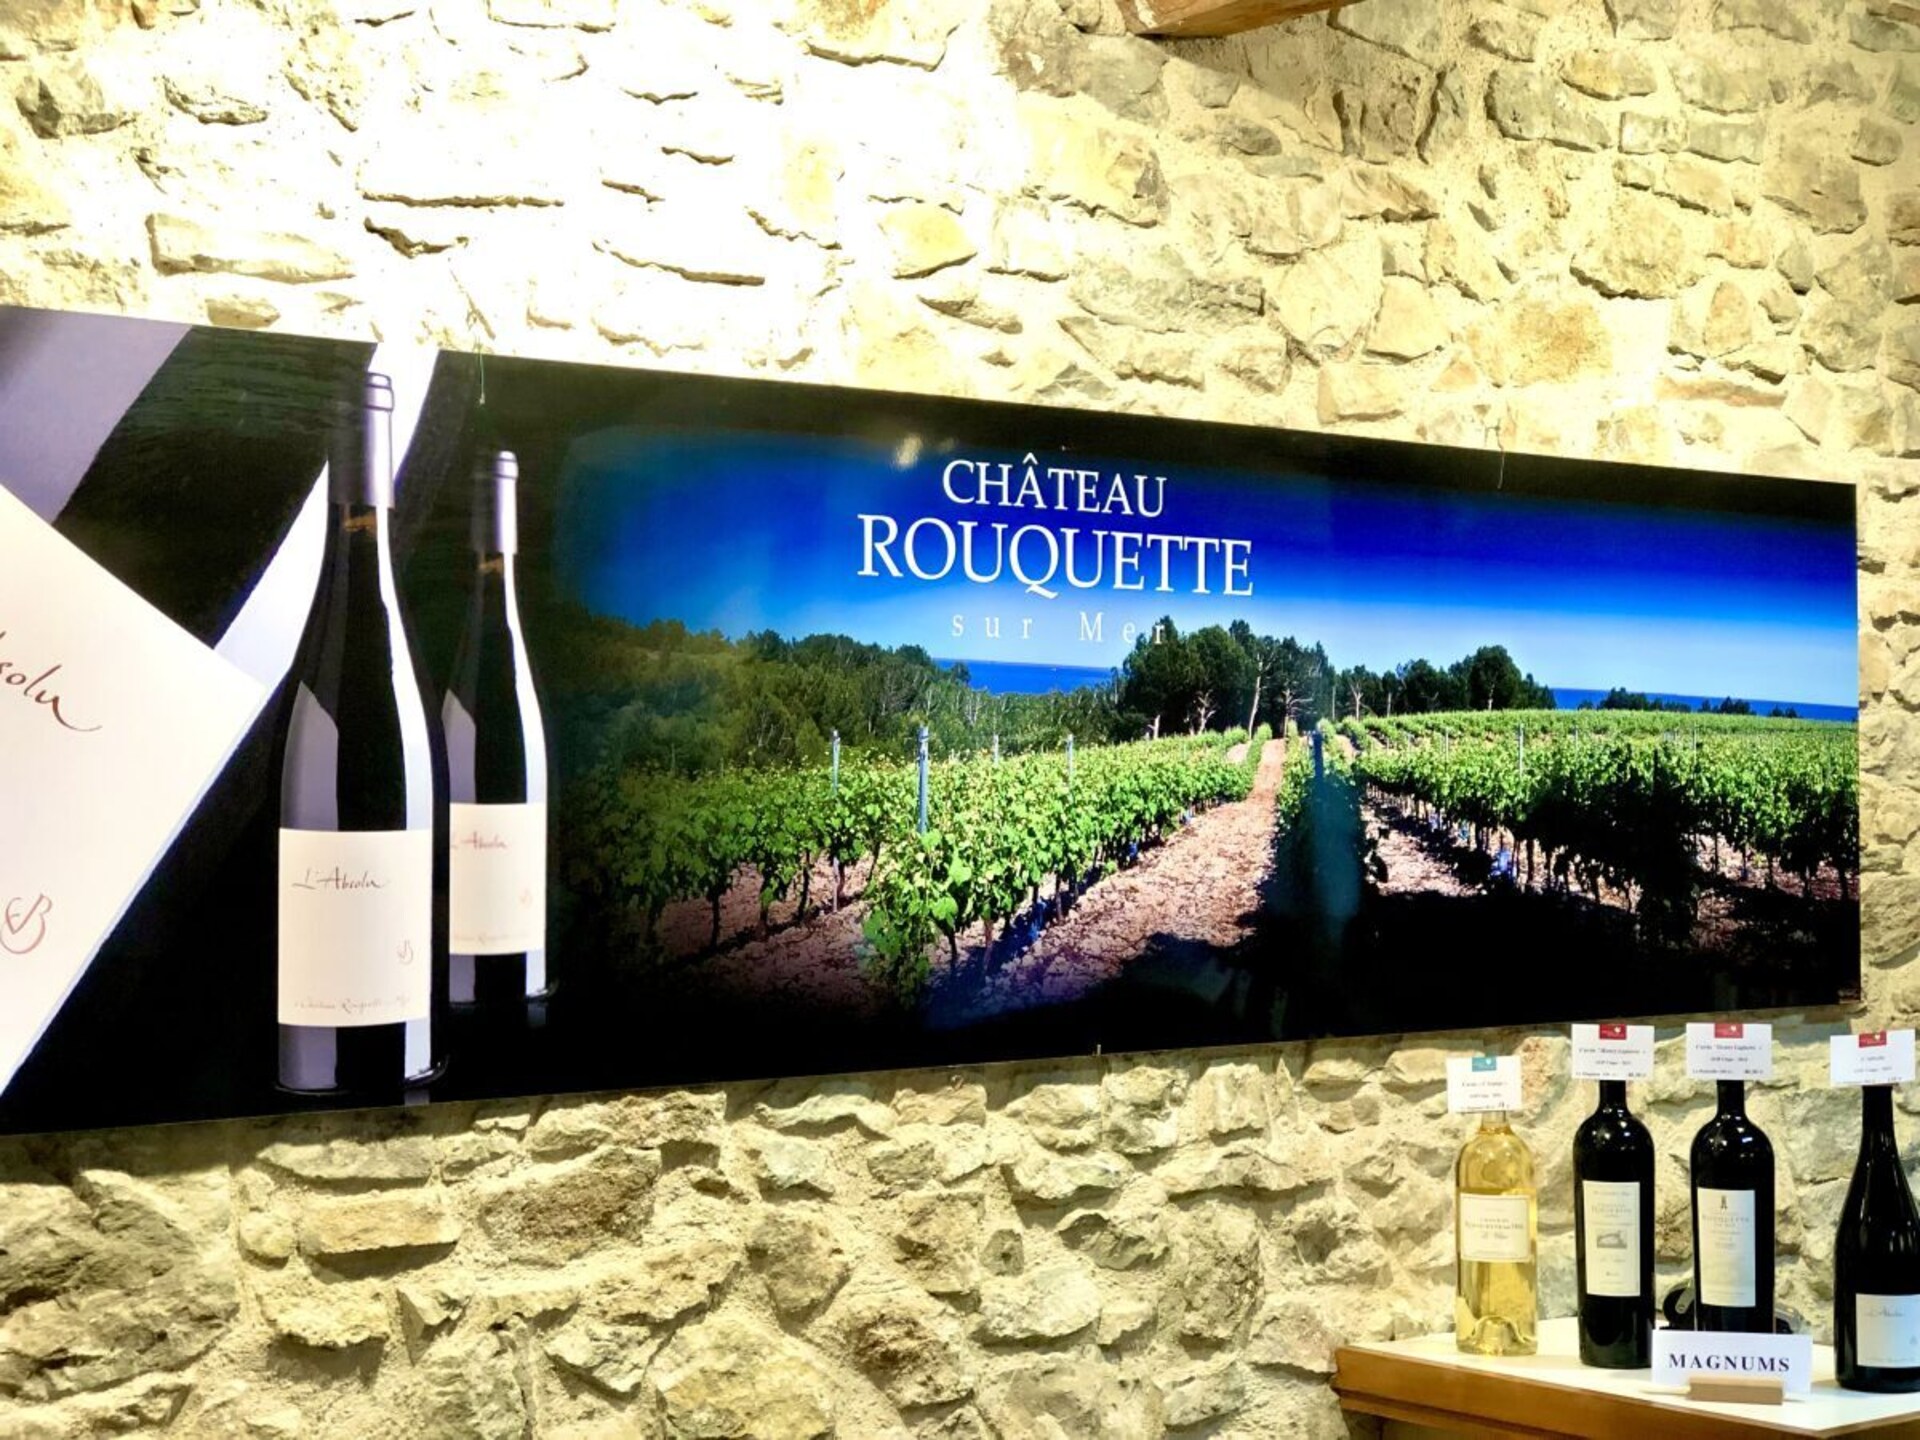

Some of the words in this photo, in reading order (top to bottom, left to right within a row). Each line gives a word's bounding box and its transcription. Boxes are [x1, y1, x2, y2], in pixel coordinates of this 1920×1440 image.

[942, 452, 1168, 518] CHÂTEAU
[856, 513, 1255, 600] ROUQUETTE
[951, 614, 1033, 640] sur
[1079, 611, 1166, 646] Mer
[1668, 1353, 1791, 1373] MAGNUMS
